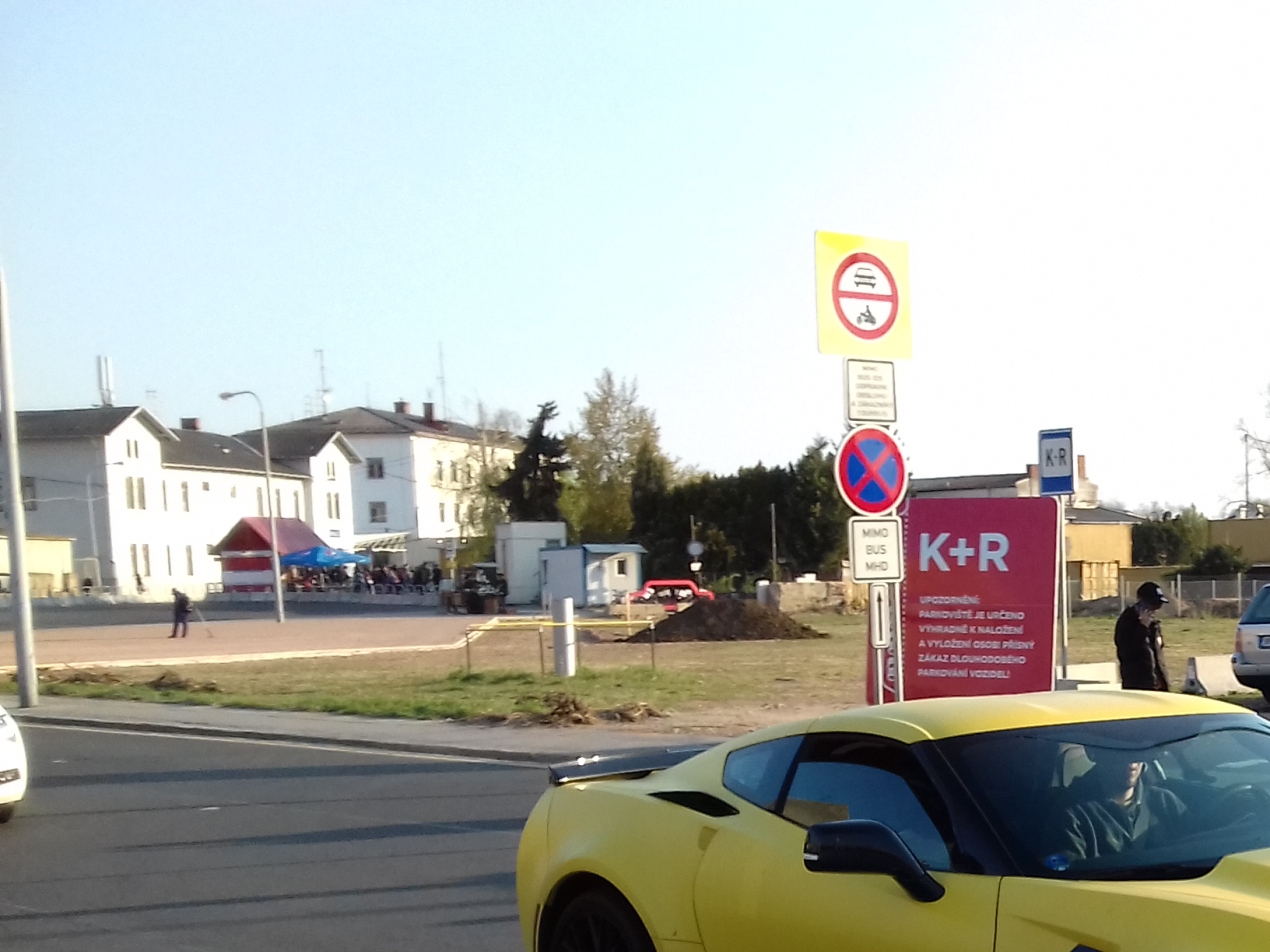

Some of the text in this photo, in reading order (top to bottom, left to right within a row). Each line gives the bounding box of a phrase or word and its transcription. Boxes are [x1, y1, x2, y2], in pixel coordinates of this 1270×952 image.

[862, 527, 888, 538] MIMO
[866, 544, 886, 555] BUS
[919, 532, 1010, 572] K+R
[866, 561, 889, 571] MHD
[974, 610, 986, 619] JE
[986, 609, 1025, 620] URČENO
[969, 626, 976, 634] K
[918, 639, 926, 647] A
[918, 652, 949, 662] ZÁKAZ
